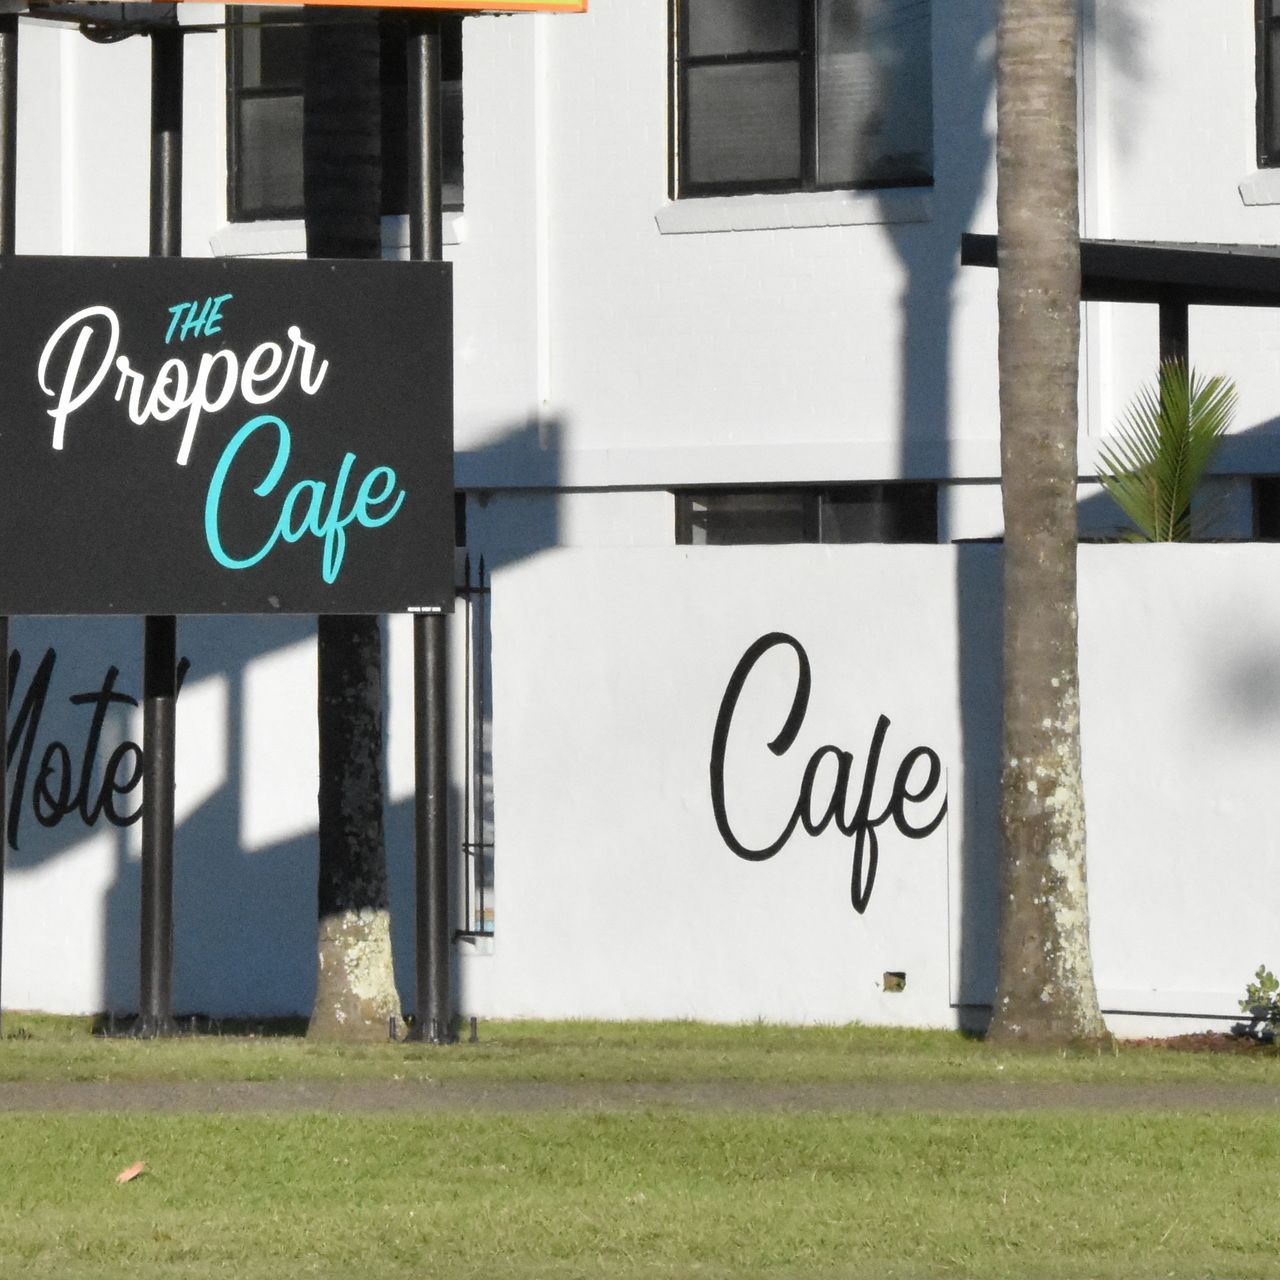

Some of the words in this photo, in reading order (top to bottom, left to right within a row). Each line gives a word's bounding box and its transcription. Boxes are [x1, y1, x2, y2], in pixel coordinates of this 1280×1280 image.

[37, 305, 329, 466] Proper
[165, 293, 233, 344] THE
[204, 415, 406, 584] Cafe
[710, 631, 948, 914] Cafe
